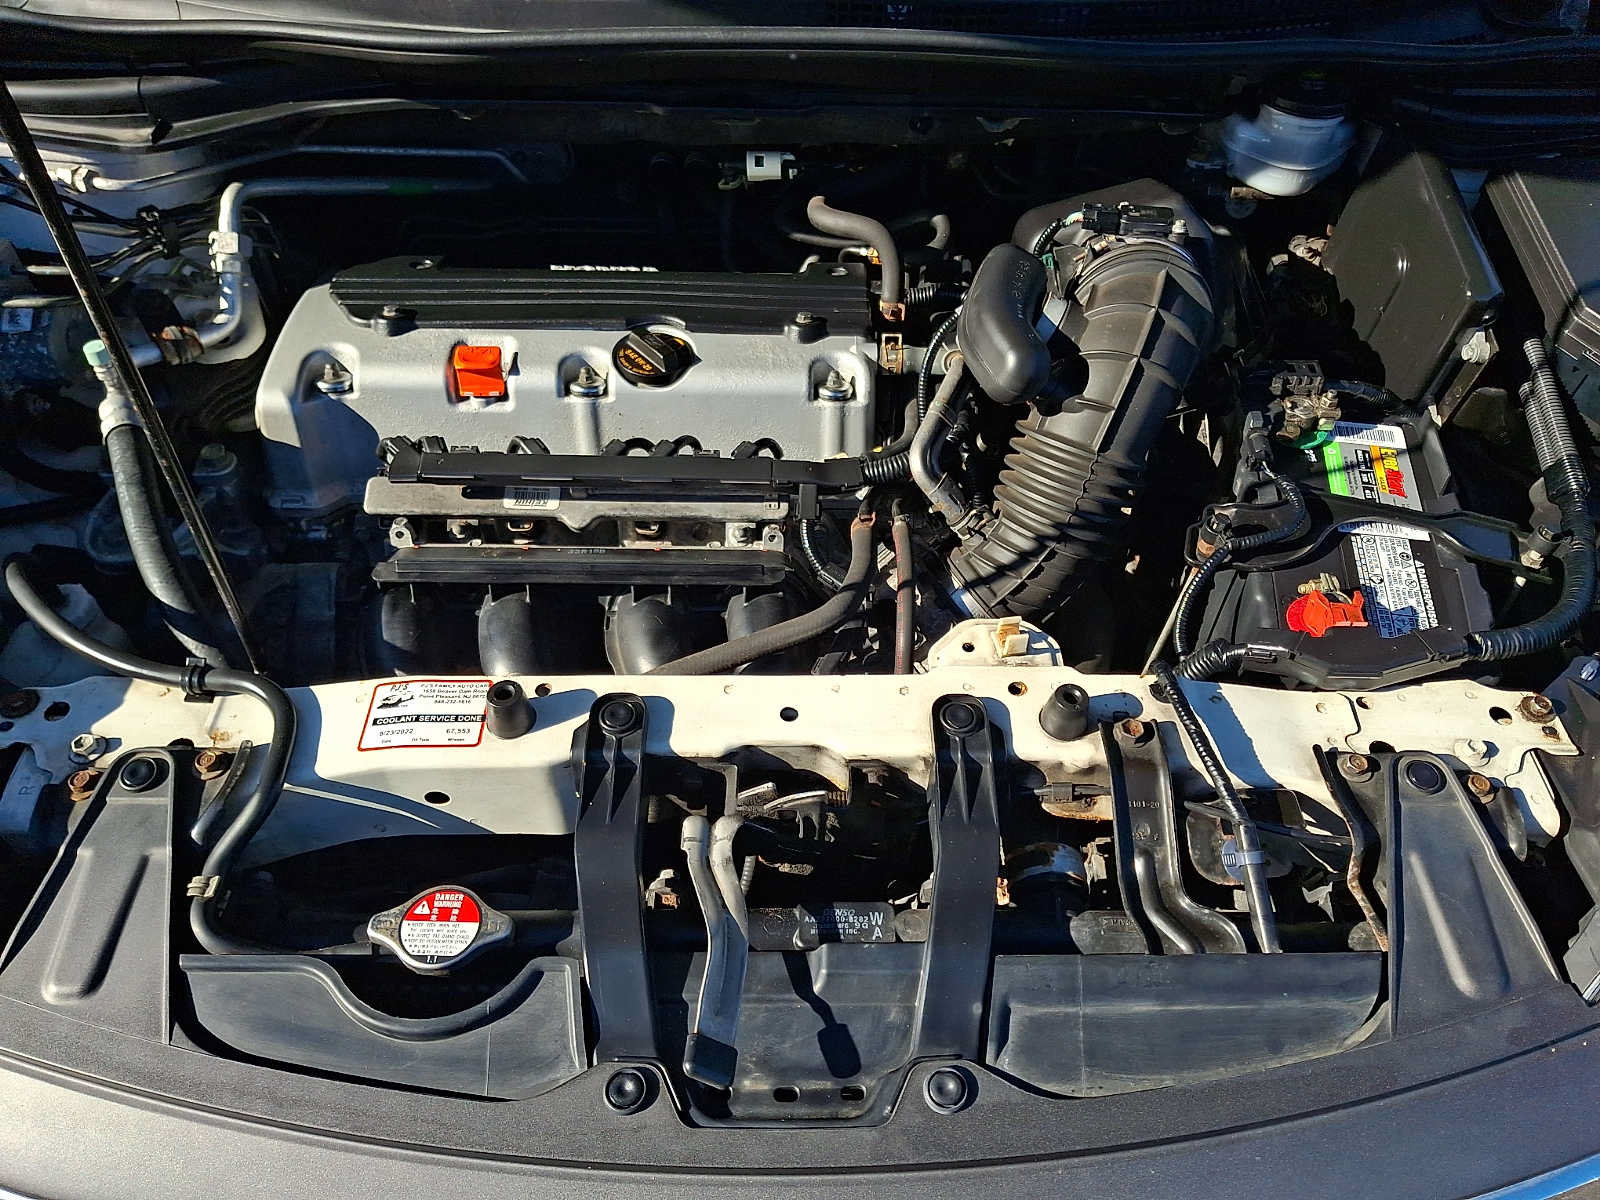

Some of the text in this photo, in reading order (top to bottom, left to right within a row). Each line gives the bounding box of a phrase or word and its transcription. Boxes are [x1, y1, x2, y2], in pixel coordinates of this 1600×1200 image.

[1379, 448, 1409, 500] EverStart
[376, 715, 418, 725] COOLANT
[435, 893, 464, 901] DANGER
[433, 900, 462, 908] WARNING
[869, 911, 884, 925] W
[872, 926, 883, 940] A
[427, 955, 437, 963] 1.1
